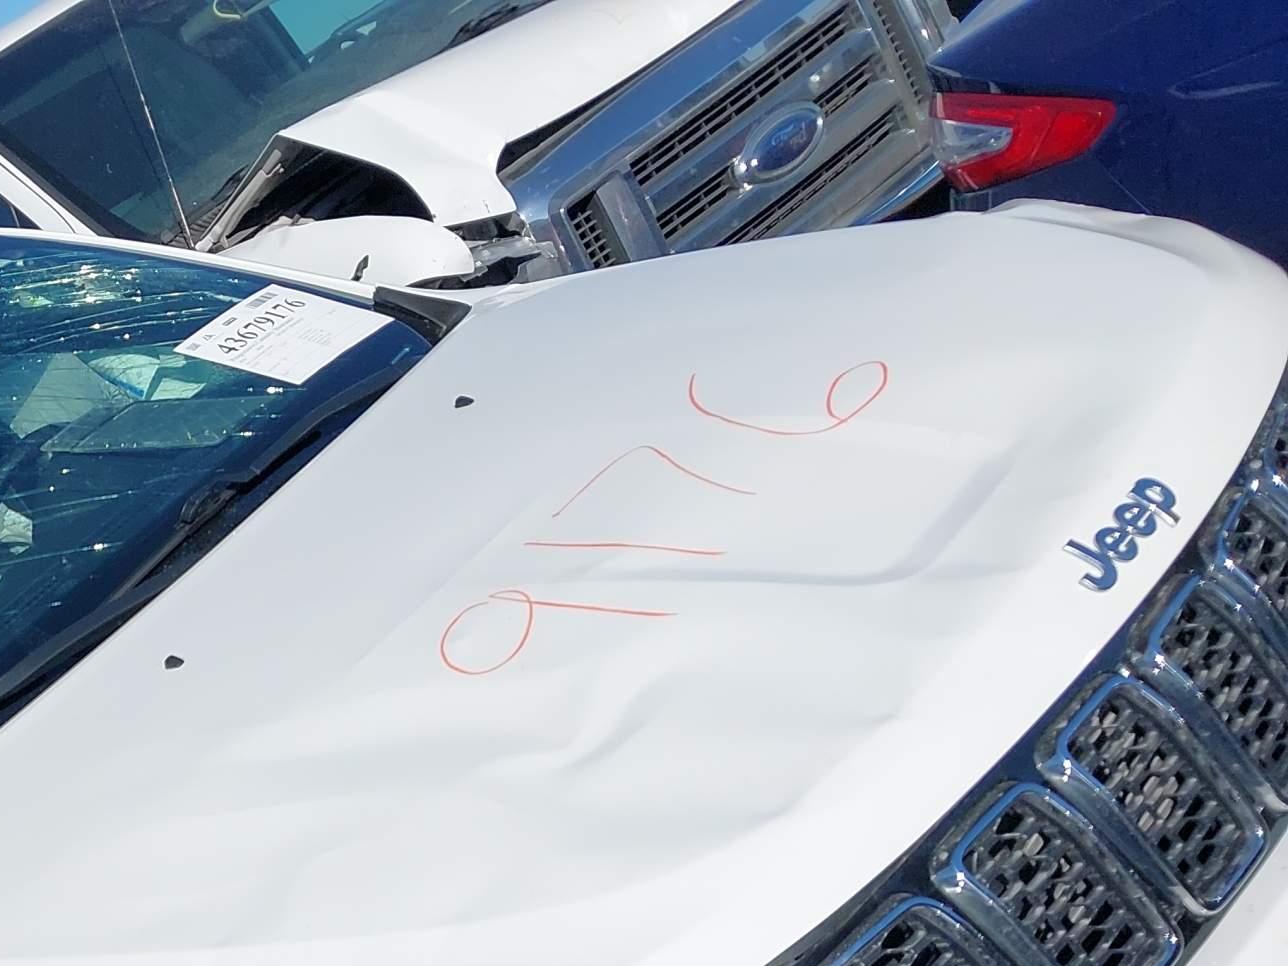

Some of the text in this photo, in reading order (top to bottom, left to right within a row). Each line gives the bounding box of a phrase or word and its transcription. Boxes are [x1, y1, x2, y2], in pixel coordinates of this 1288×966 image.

[217, 298, 306, 354] 43679176
[440, 360, 888, 675] 9176
[1062, 477, 1181, 592] Jeep
